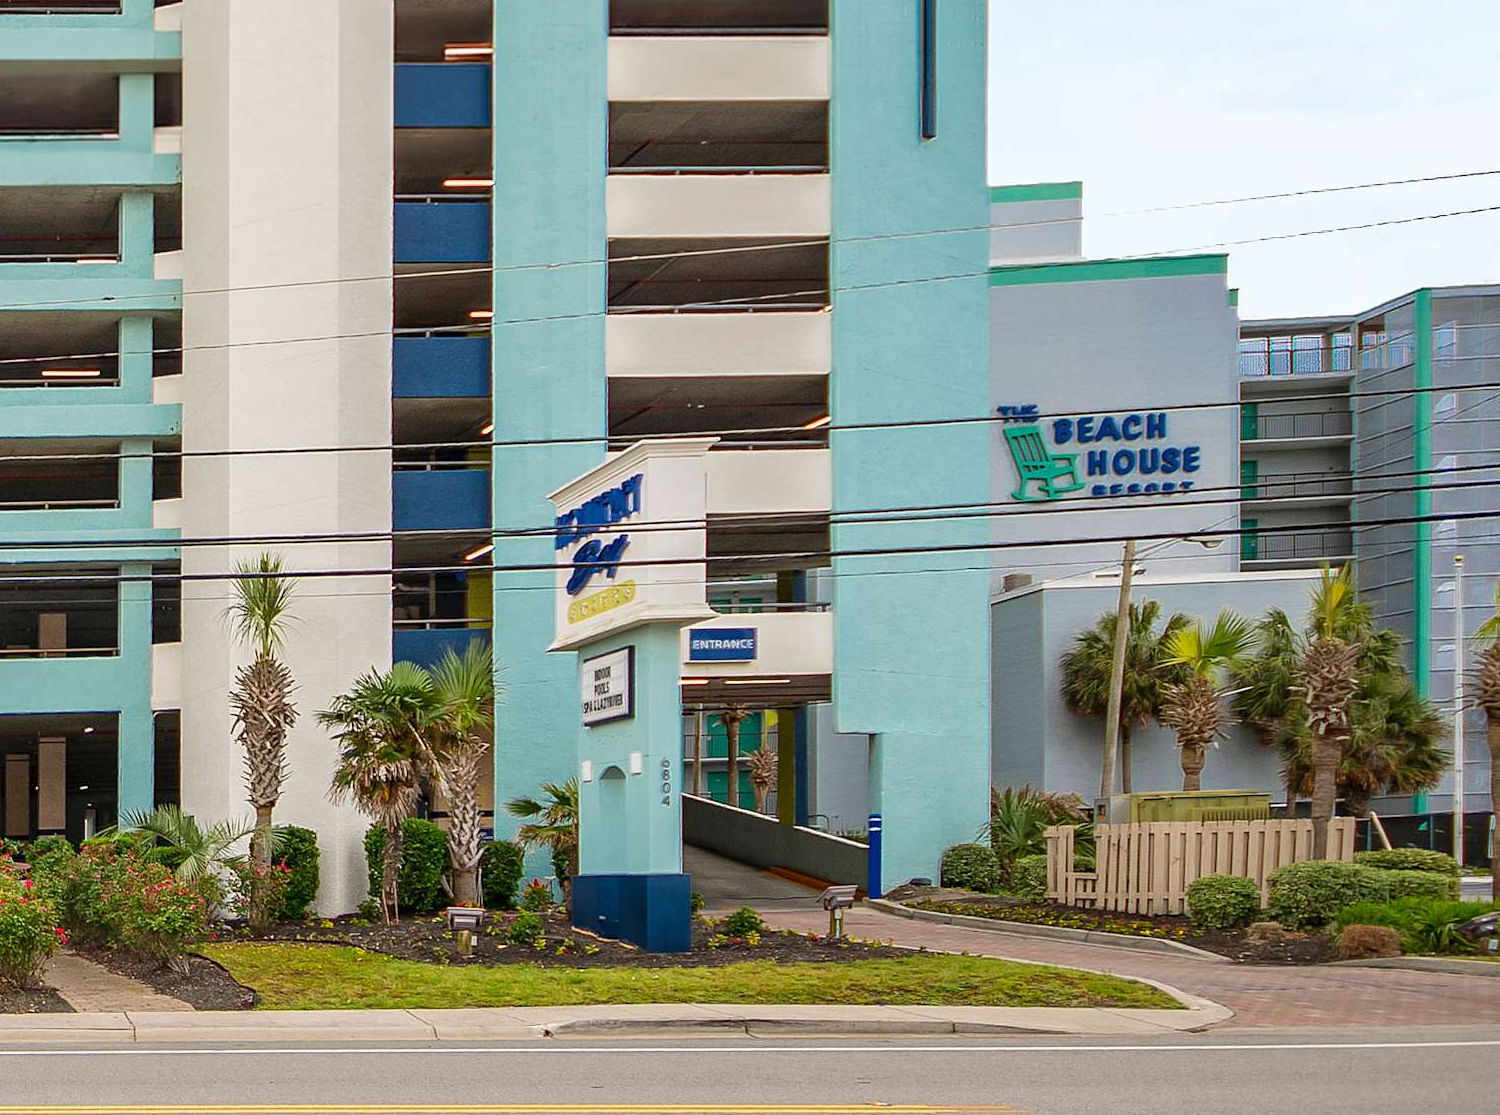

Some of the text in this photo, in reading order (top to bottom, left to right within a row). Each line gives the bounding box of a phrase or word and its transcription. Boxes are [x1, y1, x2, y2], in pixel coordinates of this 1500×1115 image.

[996, 404, 1039, 424] THE
[1053, 412, 1167, 445] BEACH
[1087, 446, 1201, 477] HOUSE
[692, 639, 755, 650] ENTRANCE
[594, 682, 609, 695] POOLS
[661, 756, 671, 807] 6804
